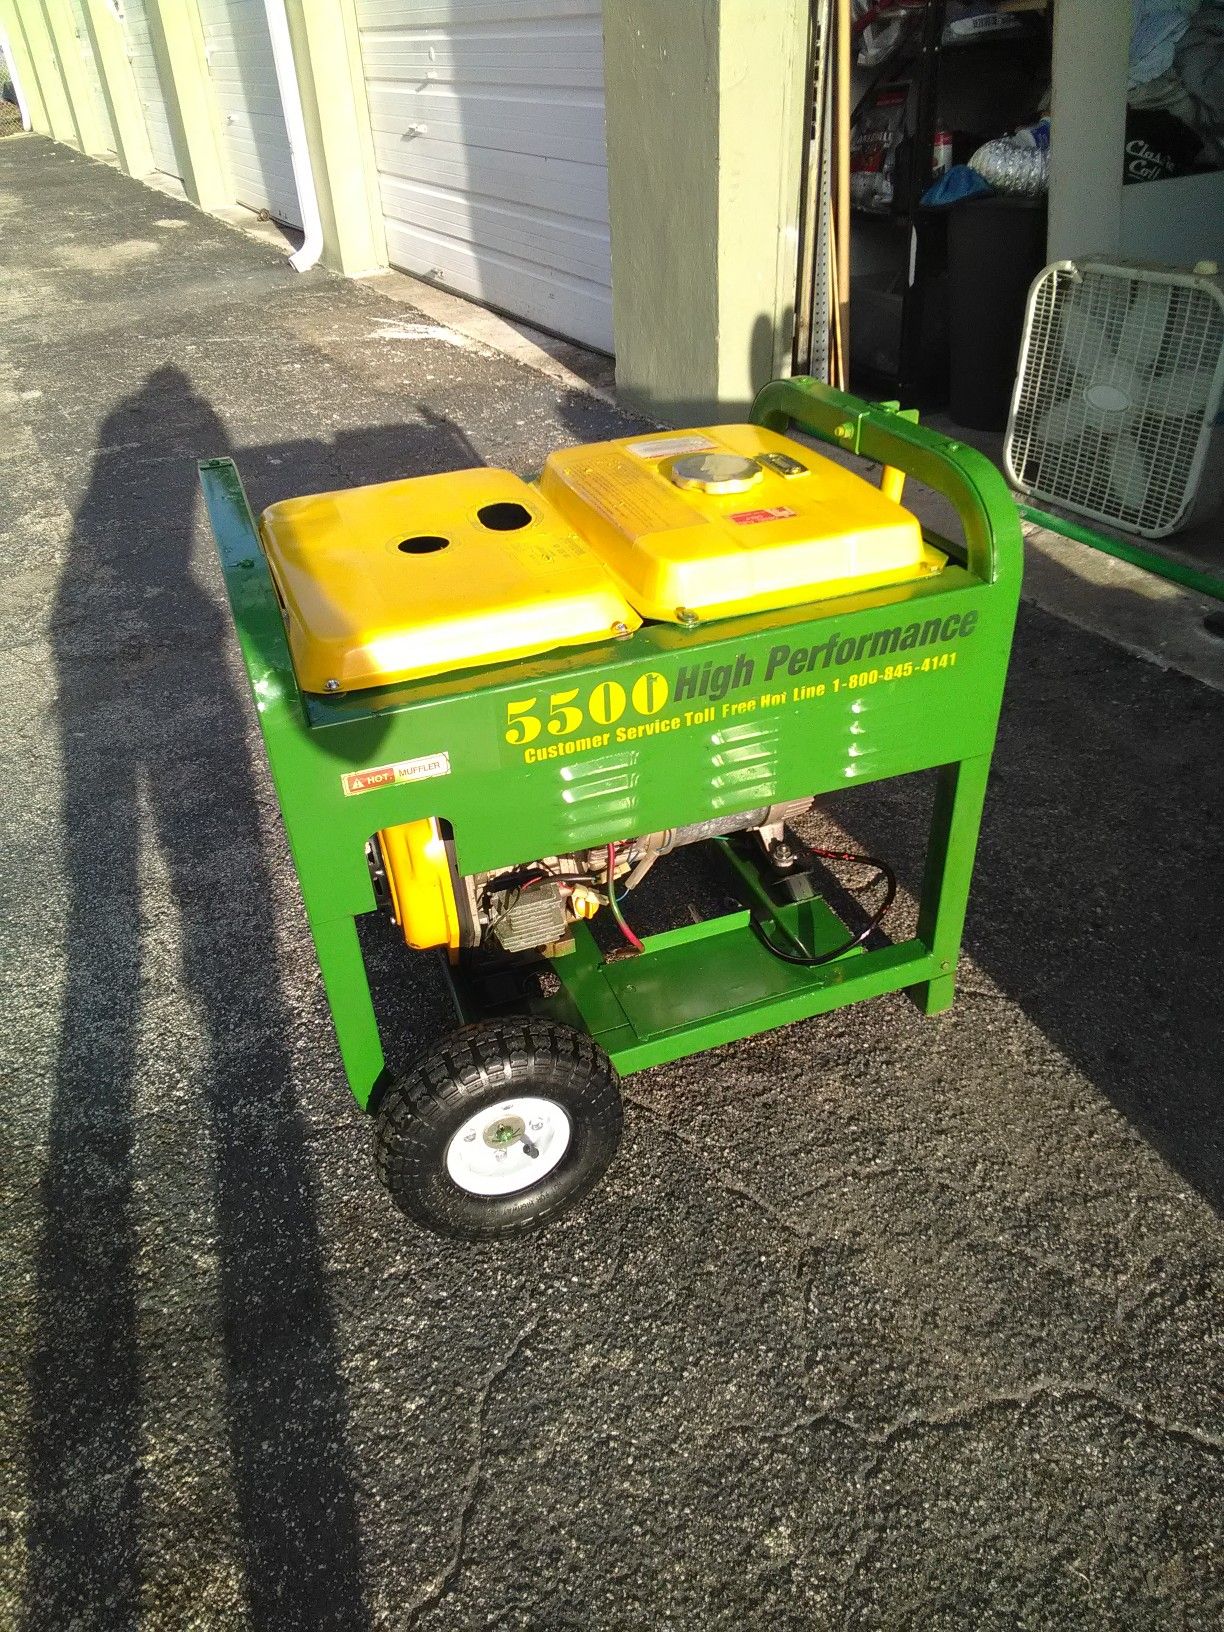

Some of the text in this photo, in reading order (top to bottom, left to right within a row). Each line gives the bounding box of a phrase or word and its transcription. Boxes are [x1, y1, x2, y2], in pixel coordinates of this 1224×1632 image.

[505, 609, 979, 745] 5500 High Performance
[524, 652, 957, 764] Customer Service Toll Free Hot Line 1-800-845-4141
[399, 761, 441, 777] MUFFLER
